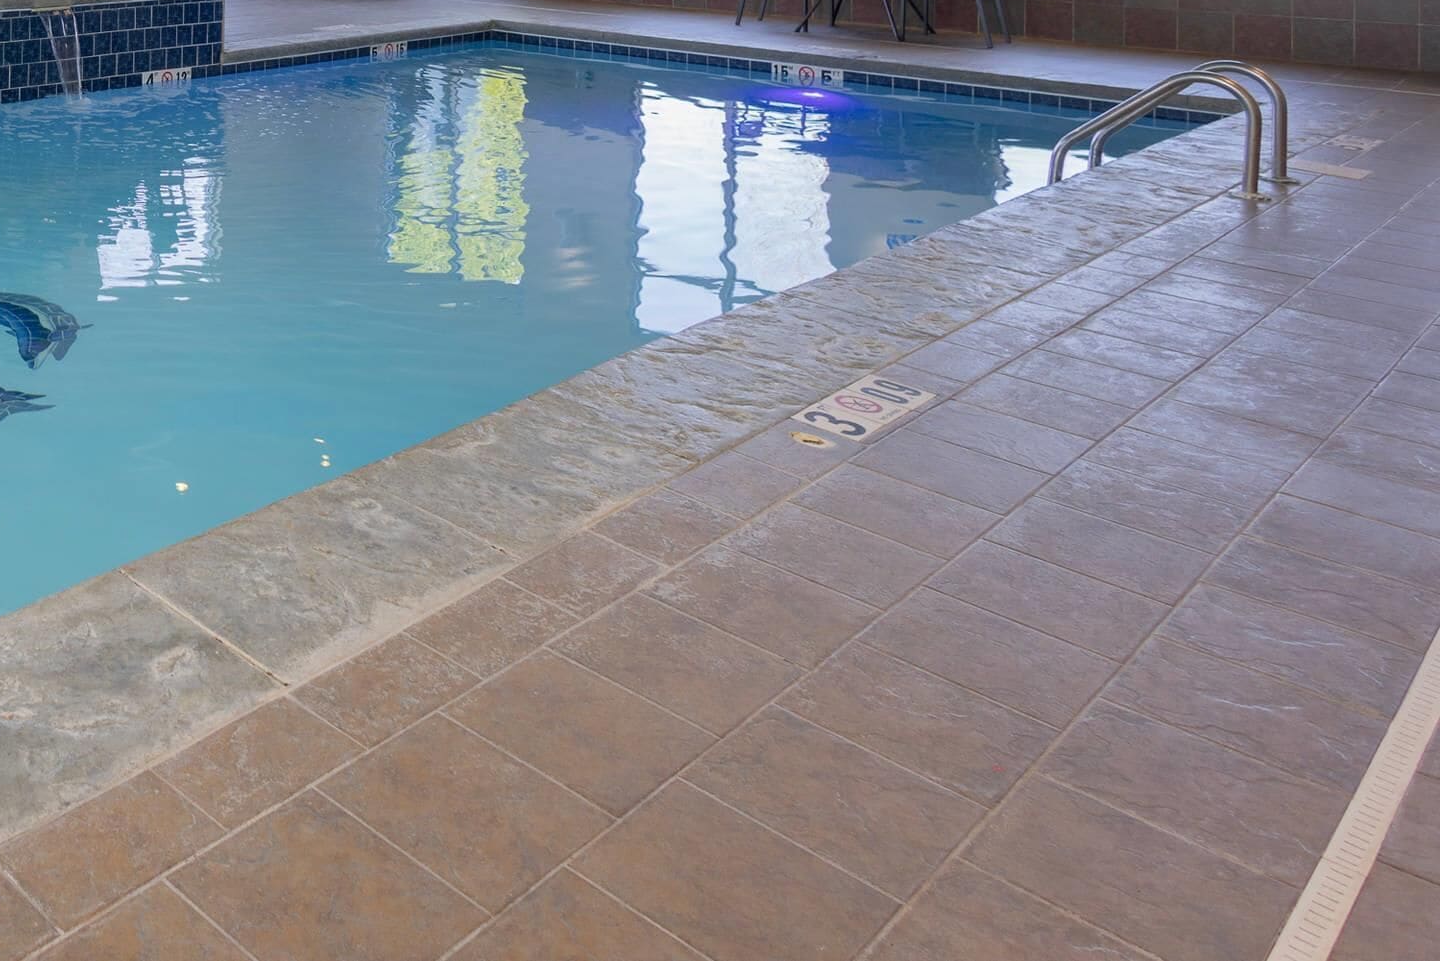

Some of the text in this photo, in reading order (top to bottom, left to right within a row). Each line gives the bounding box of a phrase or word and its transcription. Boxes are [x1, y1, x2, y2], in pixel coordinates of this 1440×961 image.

[822, 70, 832, 81] 5
[804, 411, 866, 436] 3
[860, 379, 921, 405] 09
